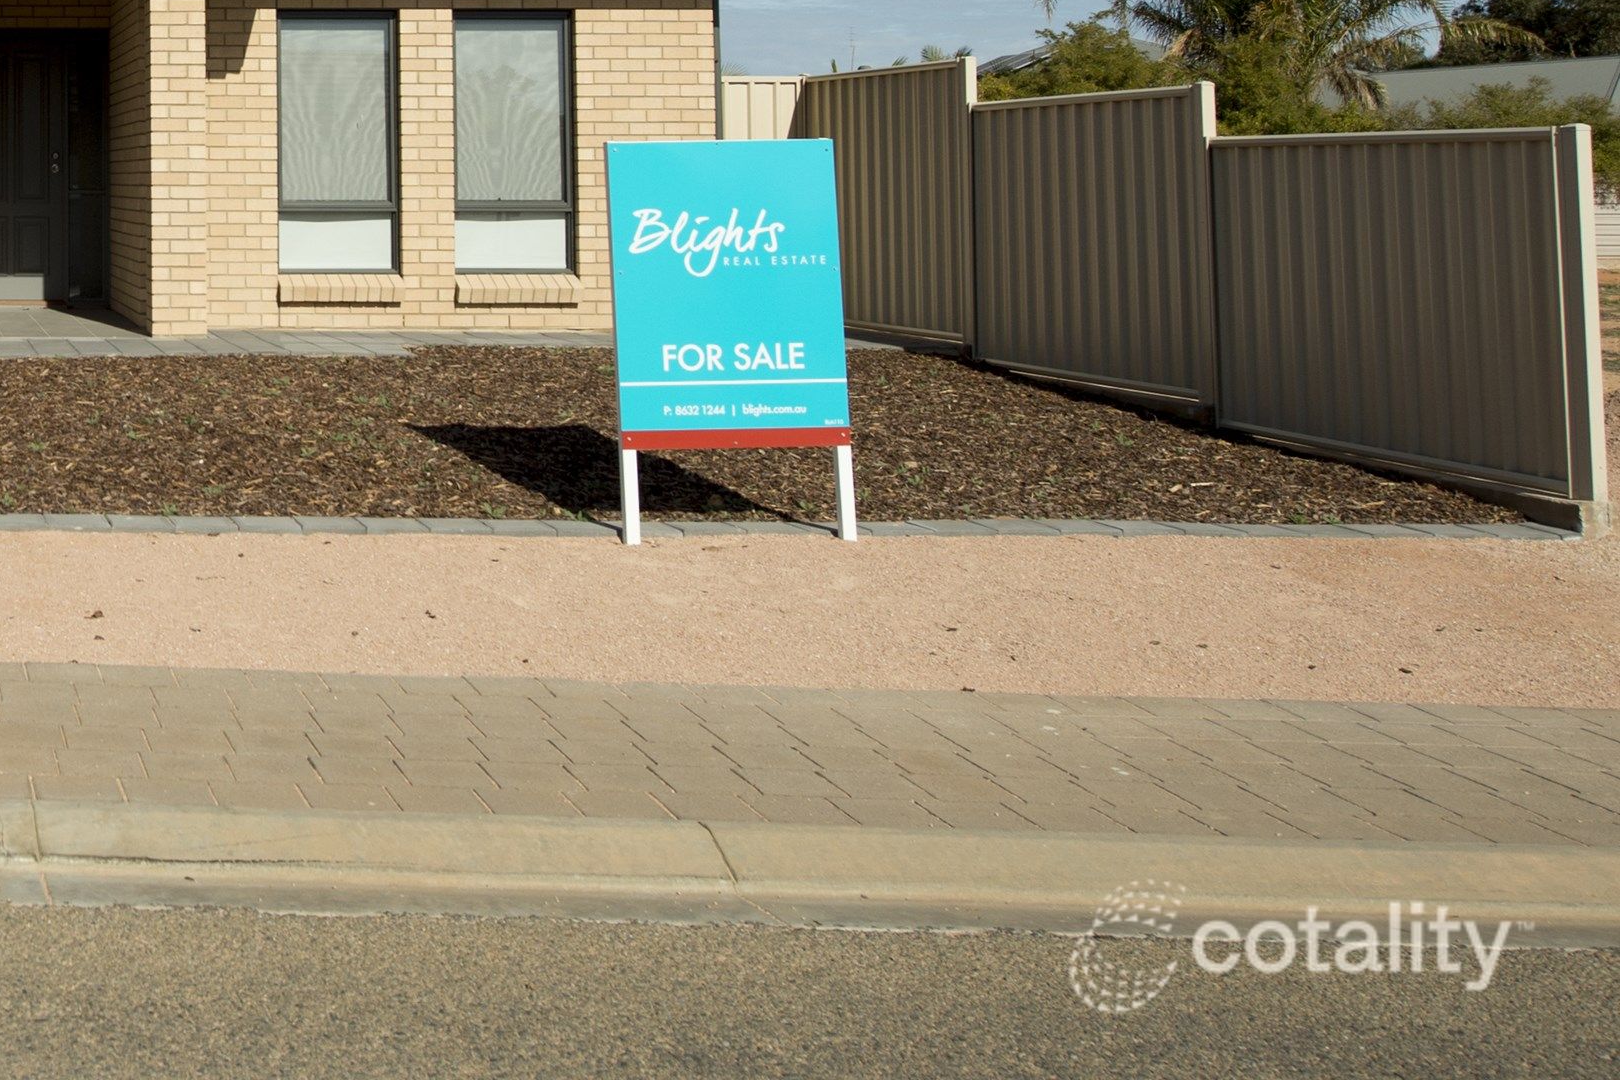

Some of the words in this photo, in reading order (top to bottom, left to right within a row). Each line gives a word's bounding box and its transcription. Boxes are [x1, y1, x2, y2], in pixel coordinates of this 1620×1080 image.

[629, 207, 786, 277] Blights
[723, 256, 761, 266] REAL
[771, 254, 828, 265] ESTATE
[662, 344, 724, 371] FOR
[734, 342, 805, 370] SALE
[675, 405, 700, 416] 8632
[702, 404, 726, 415] 1244
[742, 403, 807, 417] blights.com.au
